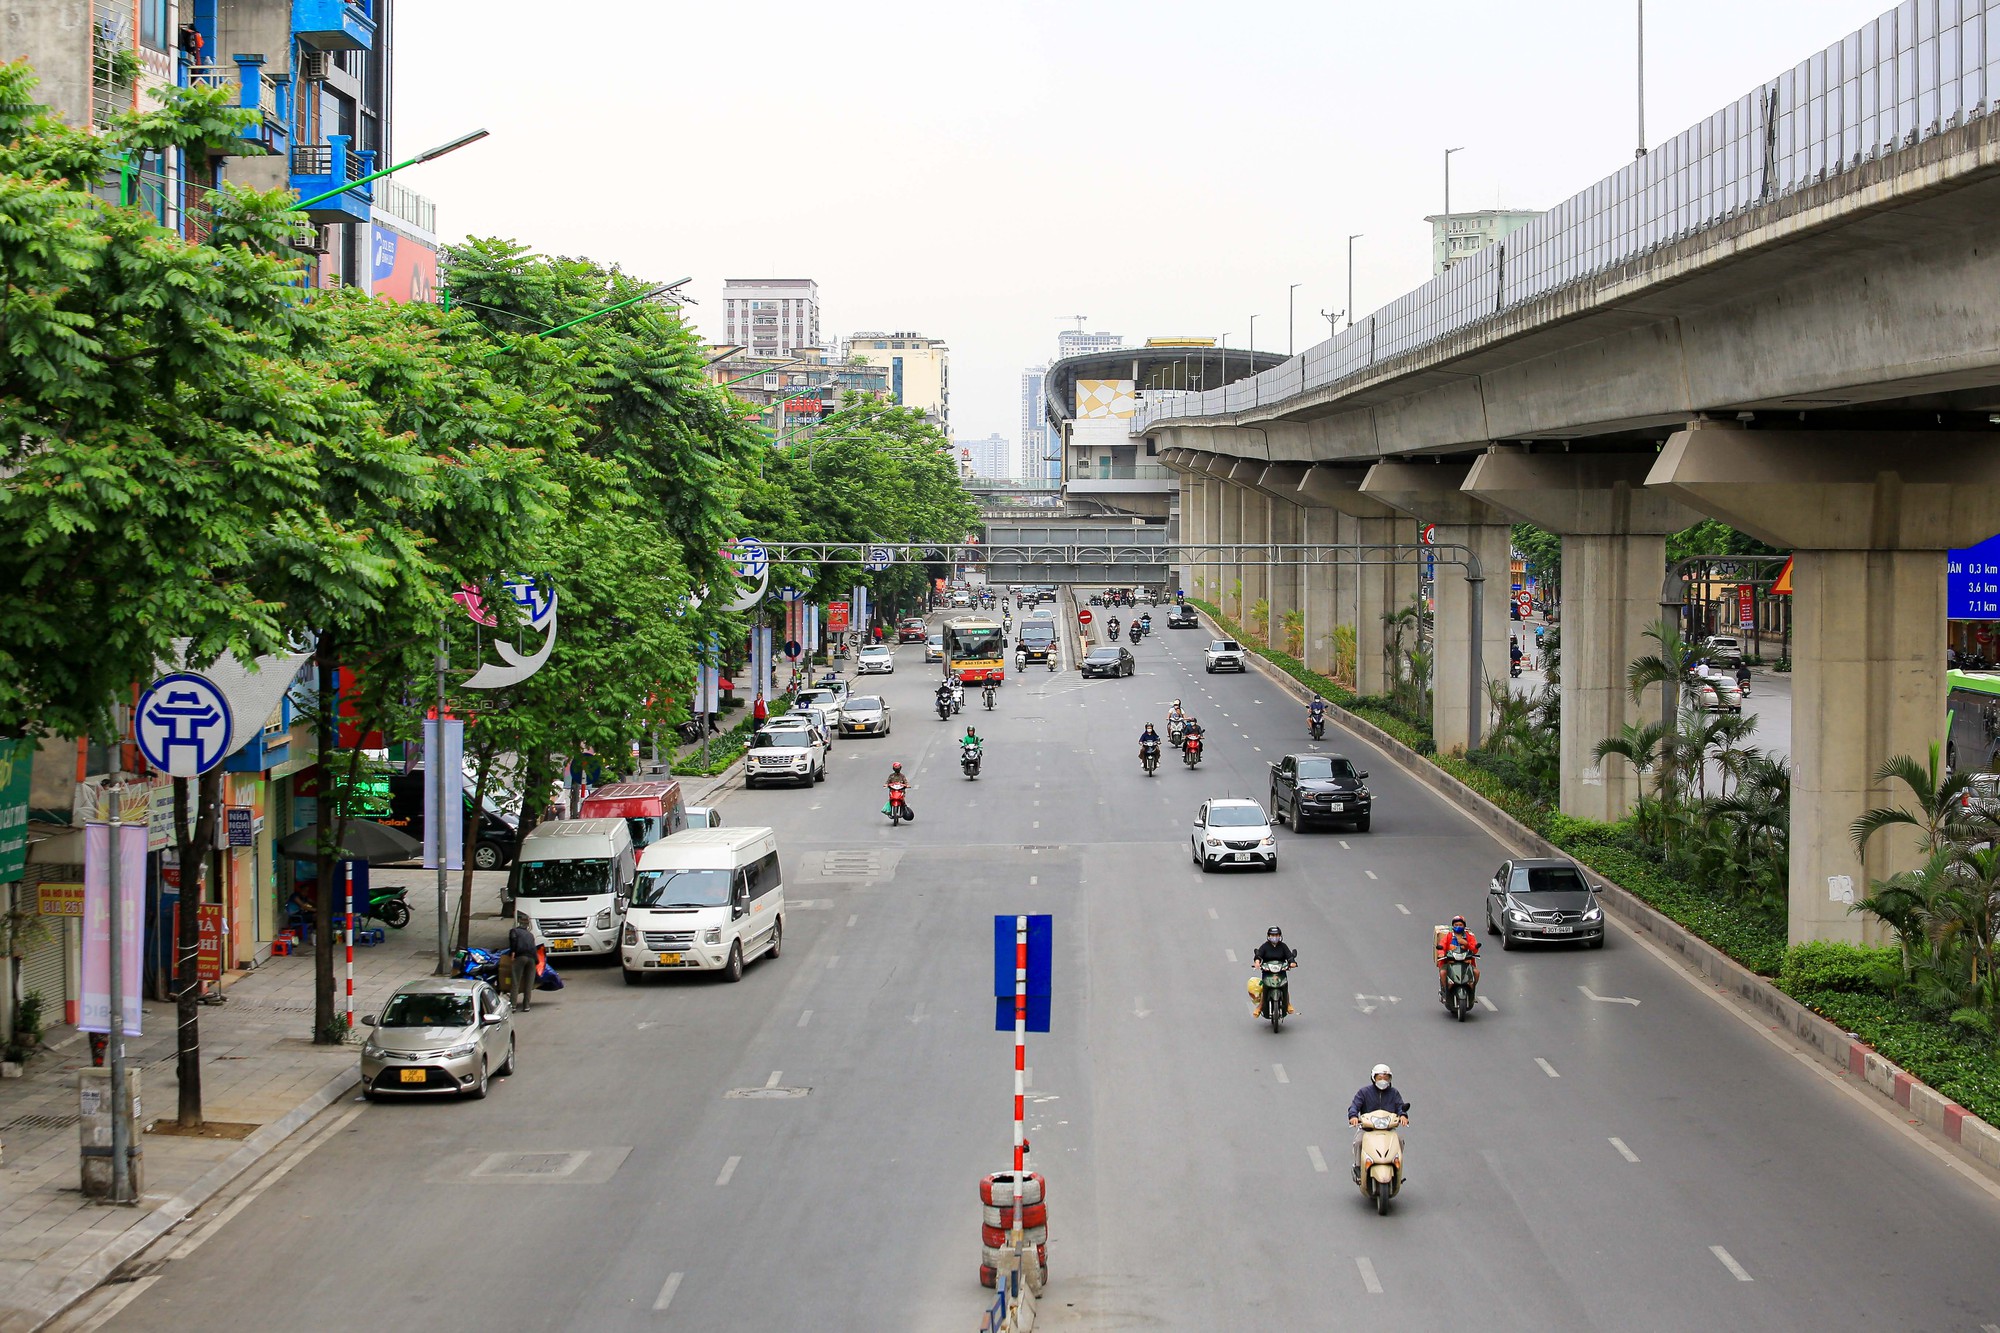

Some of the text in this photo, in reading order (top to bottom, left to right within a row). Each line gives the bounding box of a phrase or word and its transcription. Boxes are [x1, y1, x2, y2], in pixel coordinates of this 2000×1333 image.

[1984, 563, 1998, 574] km
[1968, 582, 1998, 593] 3.6 km
[1969, 601, 1997, 612] 7.1 km
[43, 900, 62, 913] BIA
